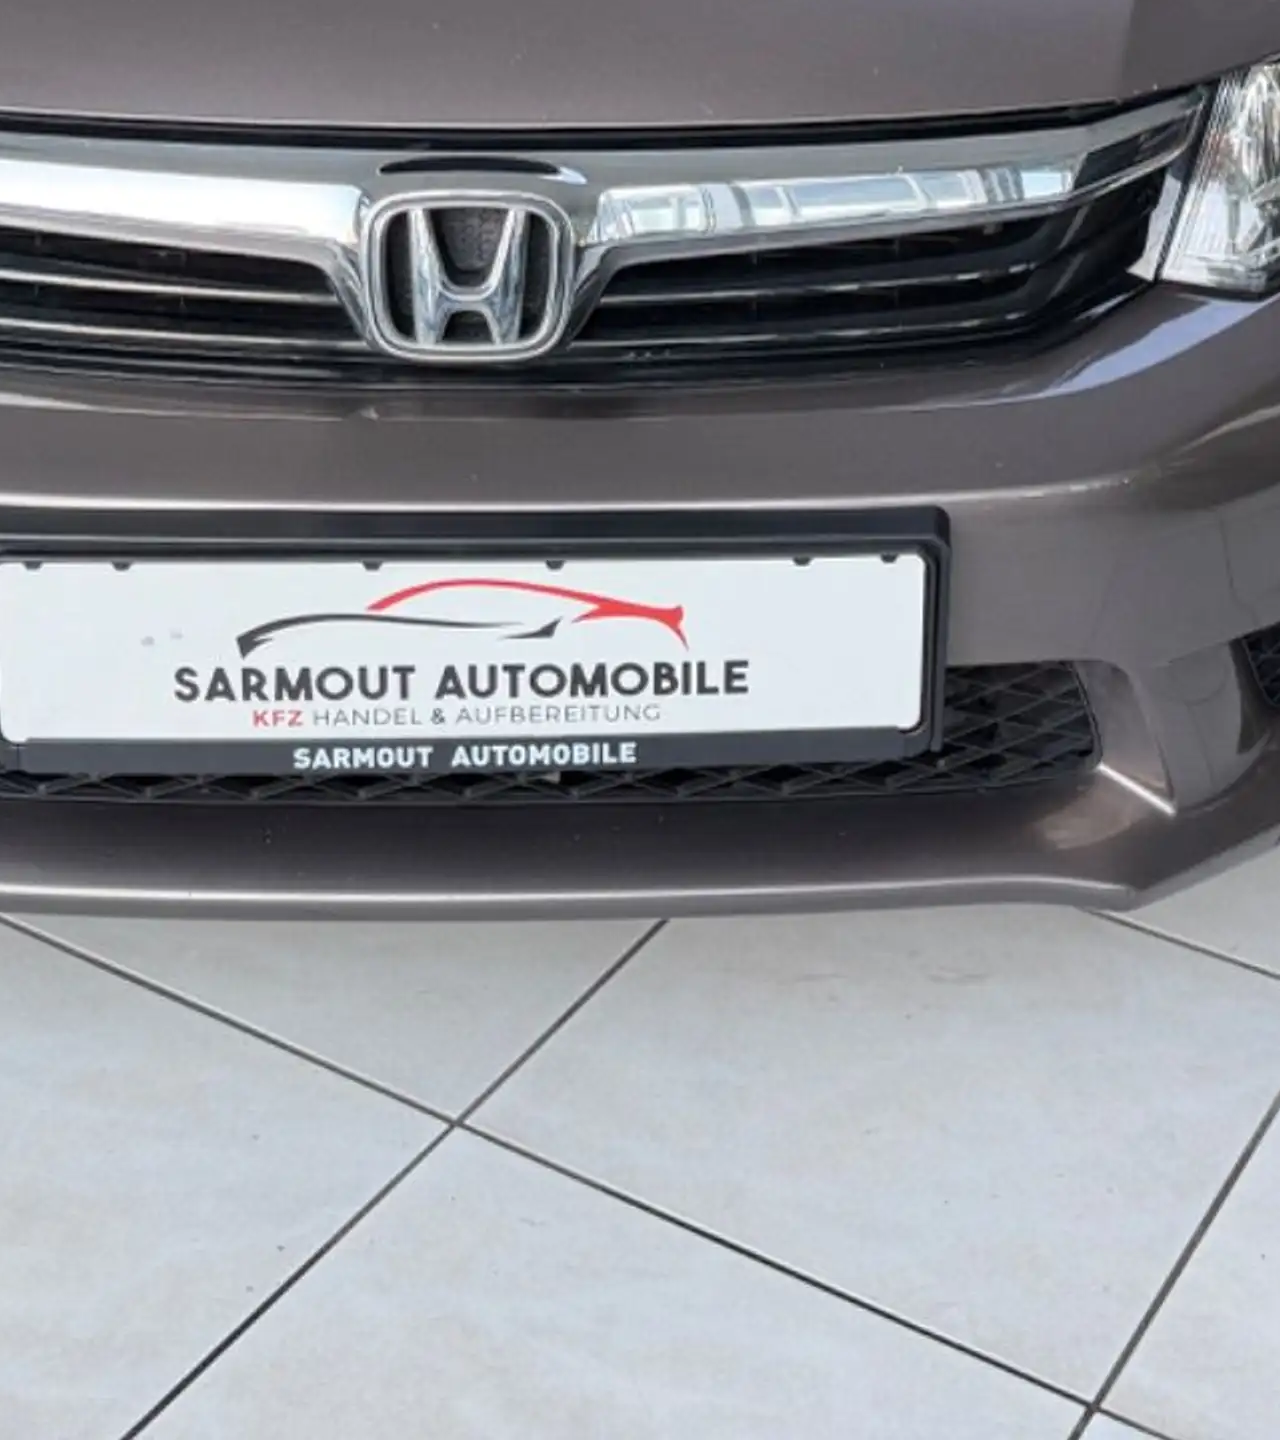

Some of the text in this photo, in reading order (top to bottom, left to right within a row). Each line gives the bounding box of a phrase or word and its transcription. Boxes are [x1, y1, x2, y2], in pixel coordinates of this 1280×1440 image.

[173, 659, 750, 703] SARMOUT AUTOMOBILE
[252, 703, 661, 728] KFZ HANDEL & AUFBEREITUNG
[293, 741, 638, 769] SARMOUT AUTOMOBILE
